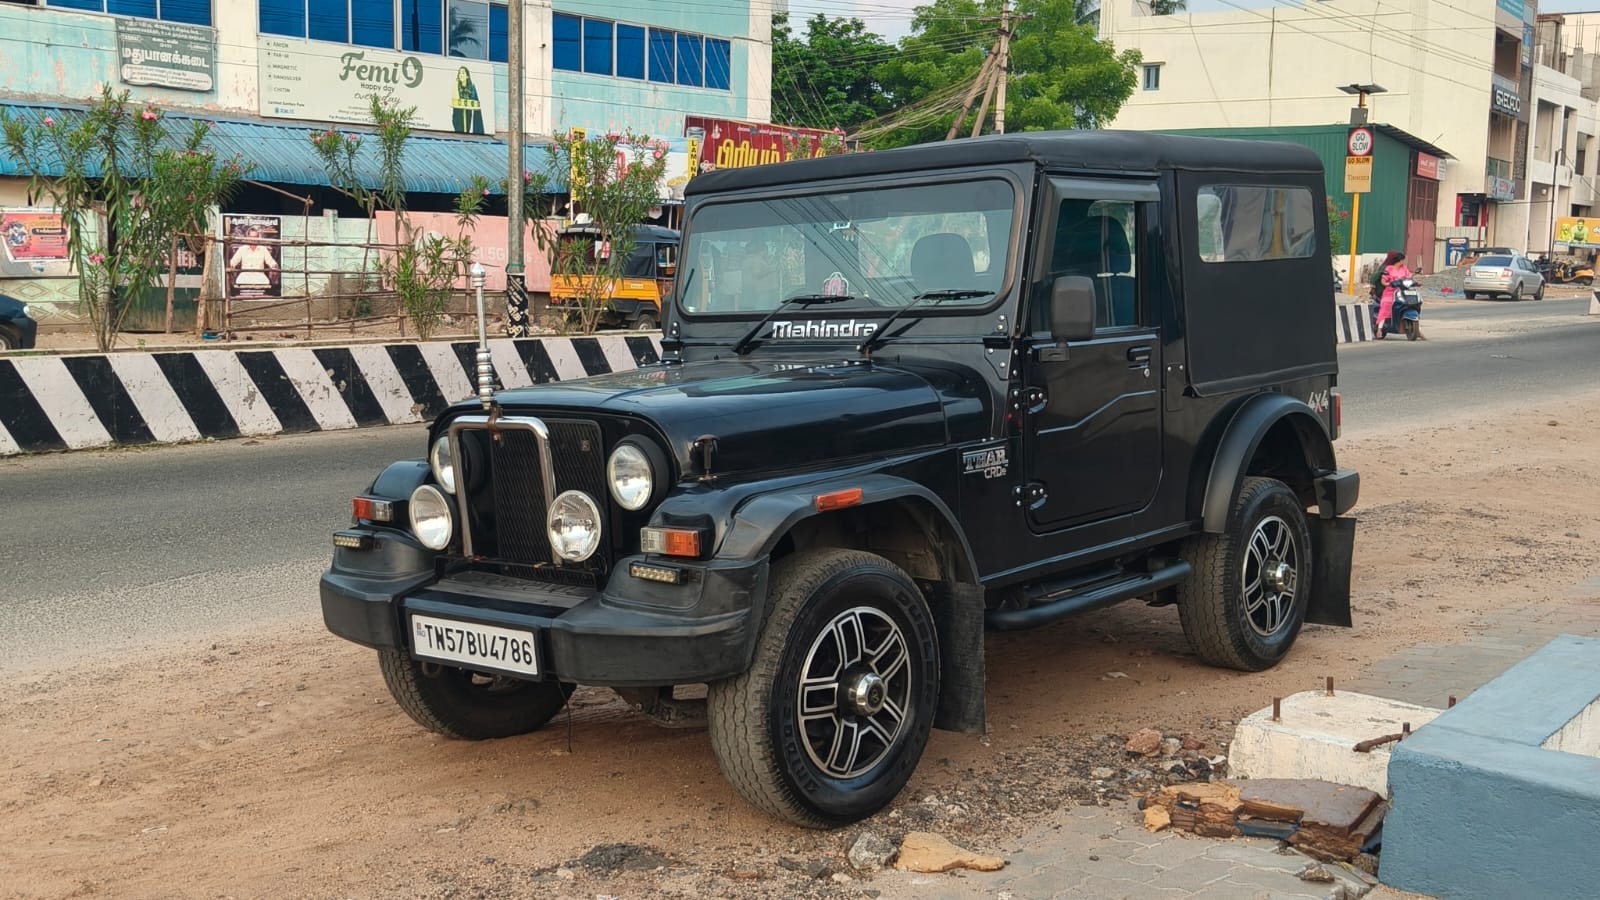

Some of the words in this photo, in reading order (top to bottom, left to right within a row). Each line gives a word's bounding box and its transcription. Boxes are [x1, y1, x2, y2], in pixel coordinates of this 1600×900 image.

[360, 82, 381, 92] Happy
[383, 83, 395, 92] day
[354, 92, 401, 106] eveday
[1355, 133, 1366, 141] GO
[1352, 142, 1369, 151] SLOW
[772, 319, 878, 338] Mahindra
[963, 449, 1008, 470] THAR
[424, 623, 533, 665] TN57BU4786
